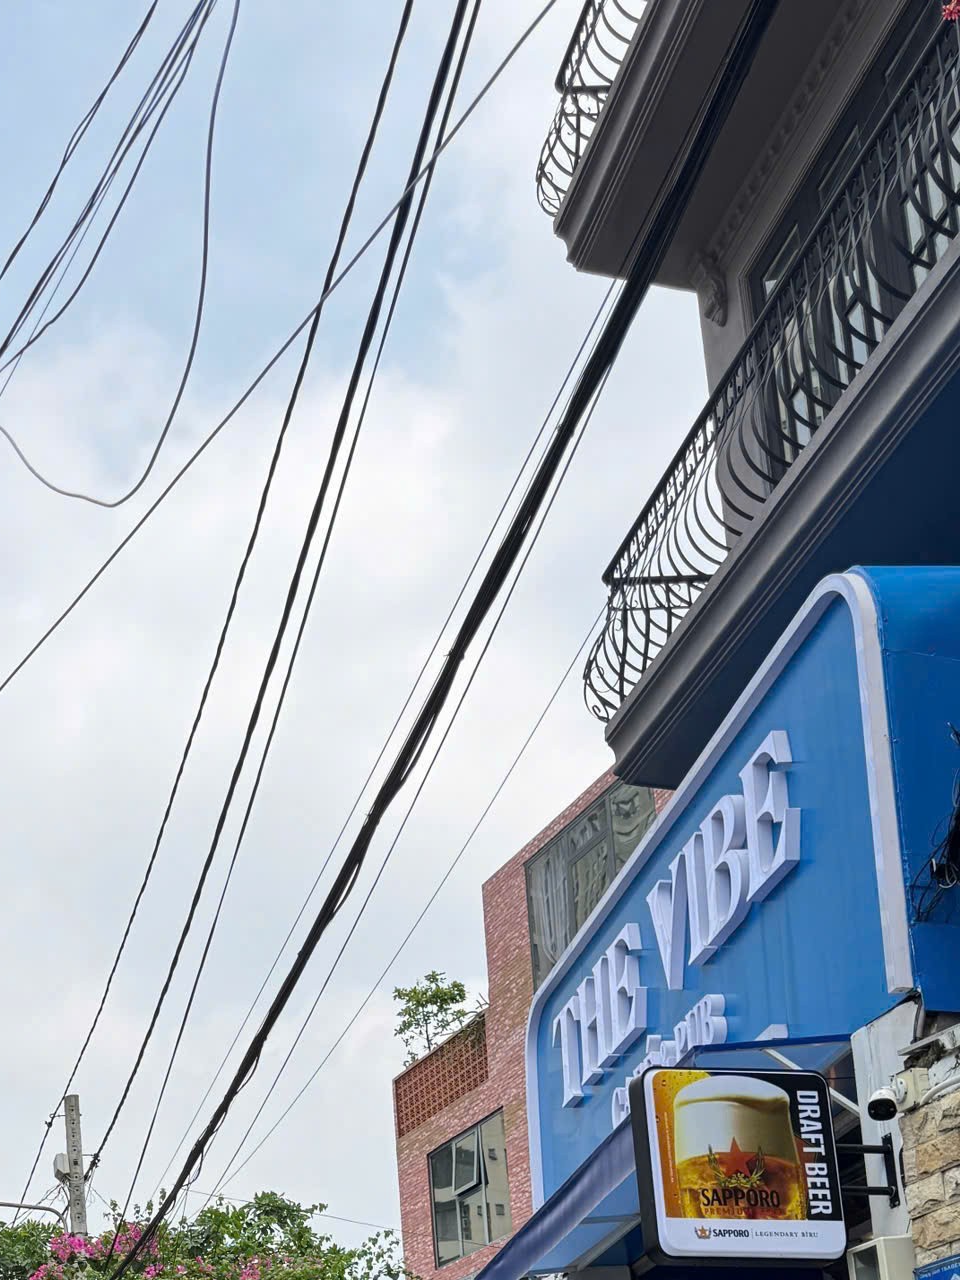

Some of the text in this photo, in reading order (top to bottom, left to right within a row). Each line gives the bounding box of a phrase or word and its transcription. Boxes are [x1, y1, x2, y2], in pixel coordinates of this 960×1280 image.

[552, 730, 801, 1109] THE VIBE
[796, 1090, 833, 1215] DRAFT BEER
[701, 1188, 780, 1208] SAPPORO
[712, 1228, 750, 1238] SAPPORO
